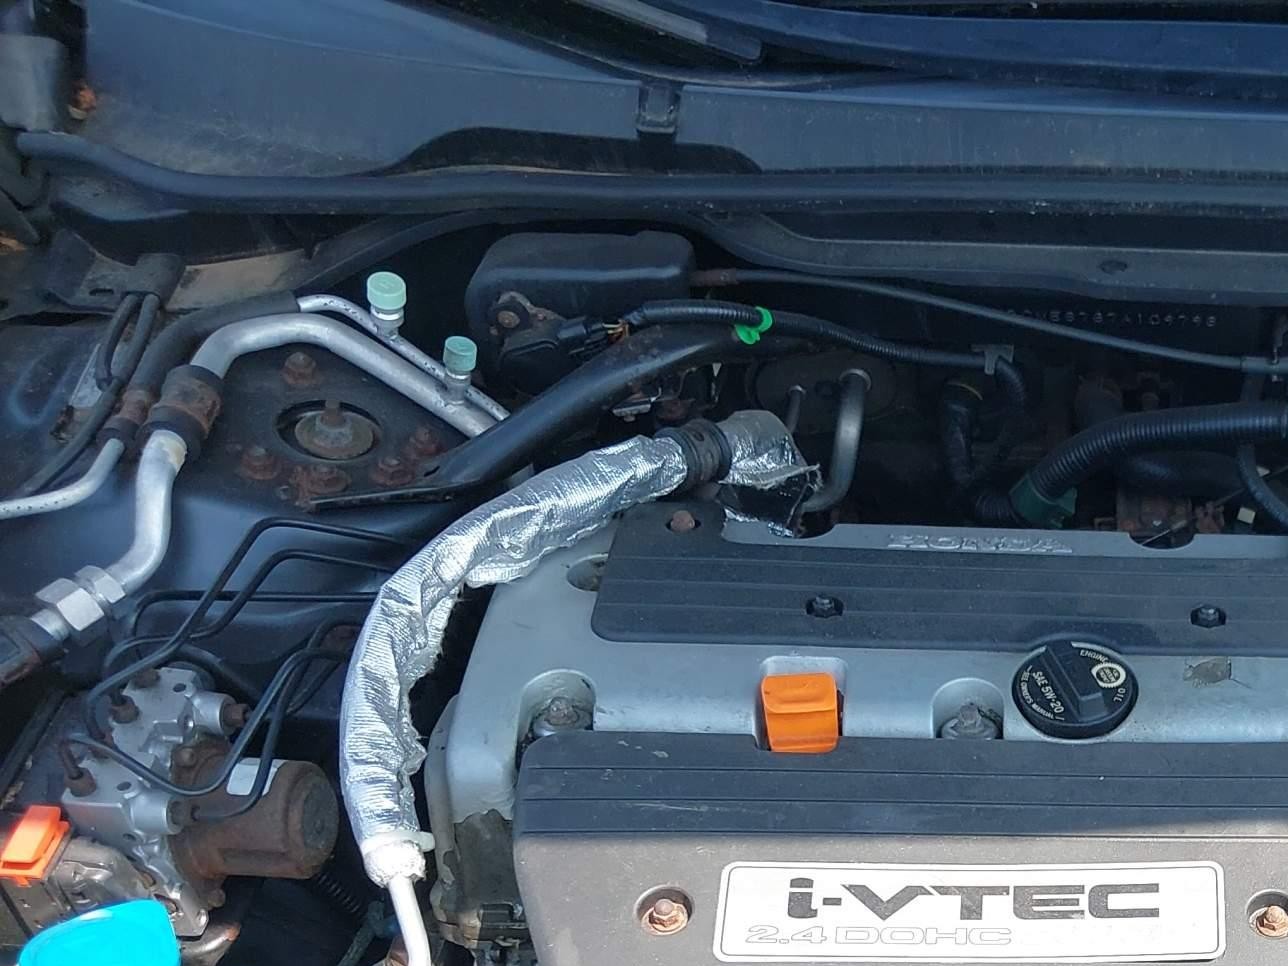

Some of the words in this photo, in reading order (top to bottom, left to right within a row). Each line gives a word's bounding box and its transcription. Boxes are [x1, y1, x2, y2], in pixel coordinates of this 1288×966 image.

[888, 534, 1072, 553] HONDA
[1032, 671, 1048, 687] SAE
[1113, 688, 1126, 702] OIL
[787, 877, 1160, 920] i-VTEC
[745, 925, 827, 944] 2.4
[835, 926, 1012, 945] DOHC
